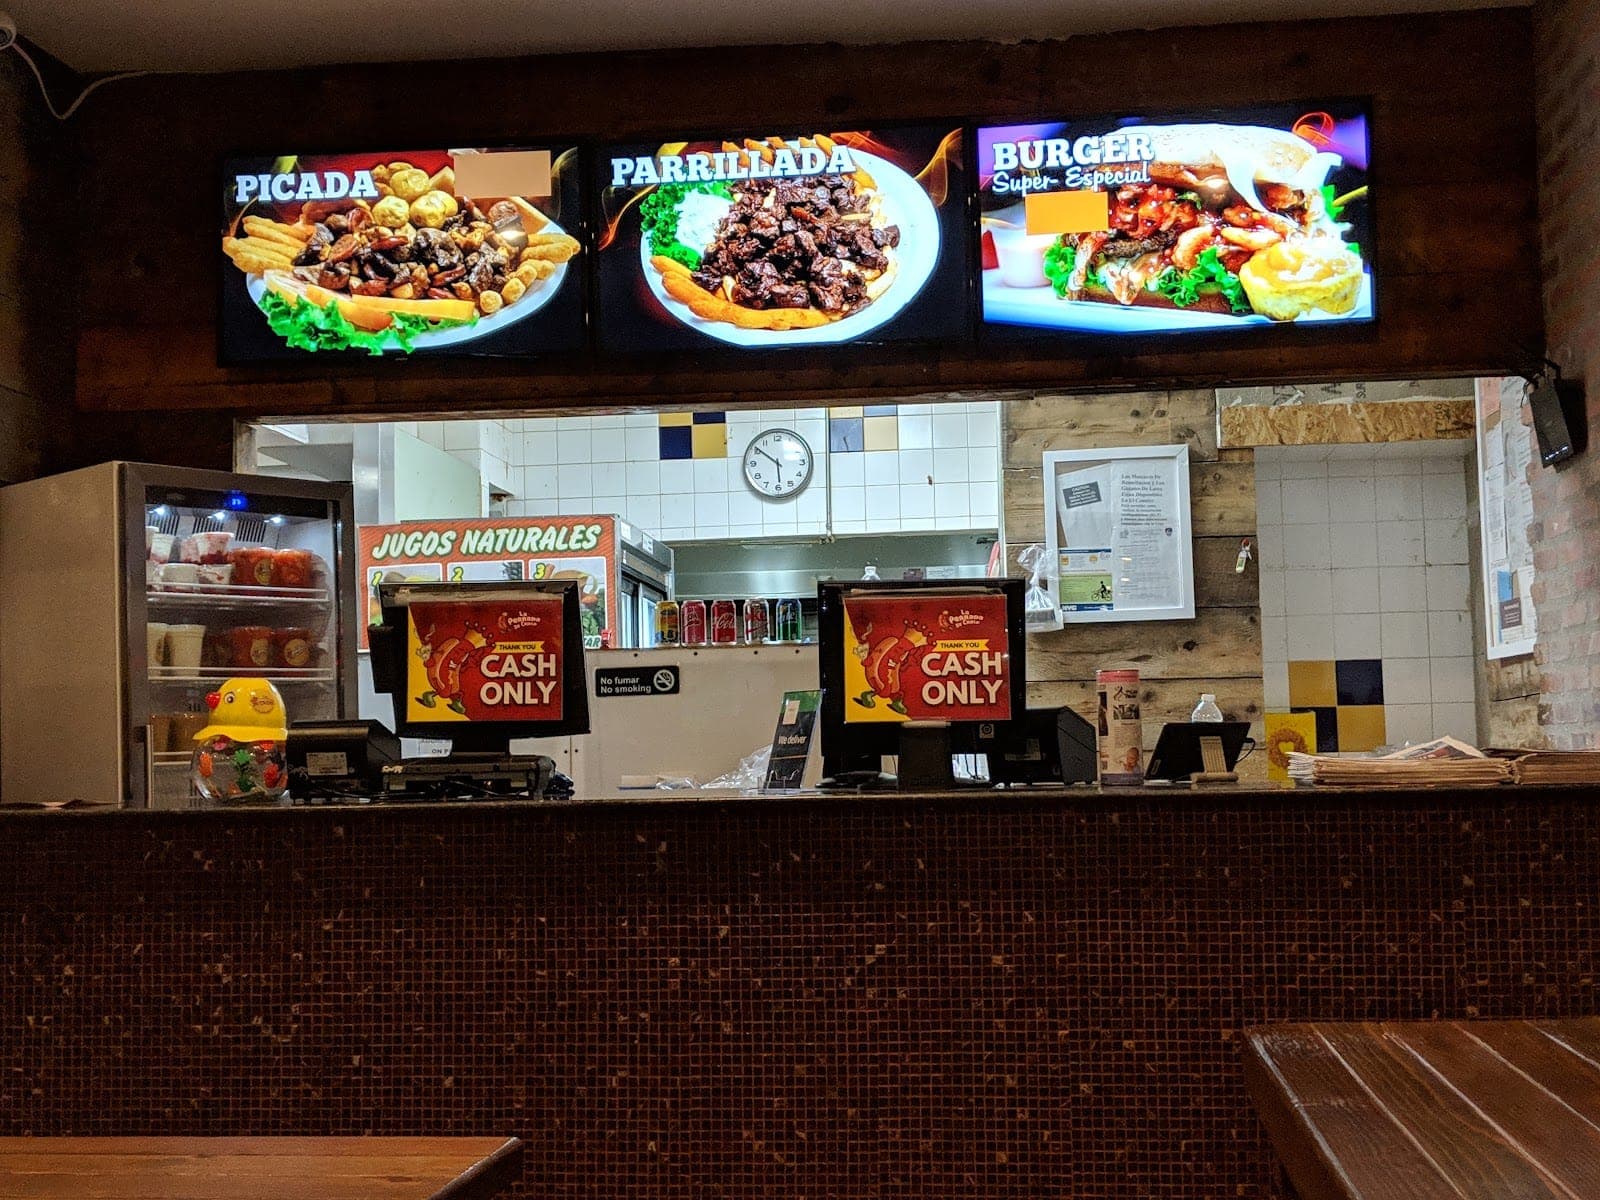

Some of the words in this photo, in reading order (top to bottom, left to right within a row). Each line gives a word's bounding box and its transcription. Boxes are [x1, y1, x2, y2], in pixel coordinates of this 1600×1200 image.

[991, 132, 1155, 172] BURGER
[611, 144, 856, 189] PARRILLADA
[1065, 162, 1151, 192] Especial
[235, 169, 379, 203] PICADA
[372, 530, 457, 560] JUGOS
[460, 524, 601, 555] NATURALES
[451, 567, 464, 582] 2
[533, 563, 546, 580] 3
[480, 654, 556, 679] CASH
[921, 652, 1002, 676] CASH
[600, 677, 613, 685] No
[614, 676, 640, 685] fumar
[614, 684, 652, 694] smoking
[921, 679, 1003, 705] ONLY
[480, 681, 556, 705] ONLY
[788, 734, 808, 744] deliver
